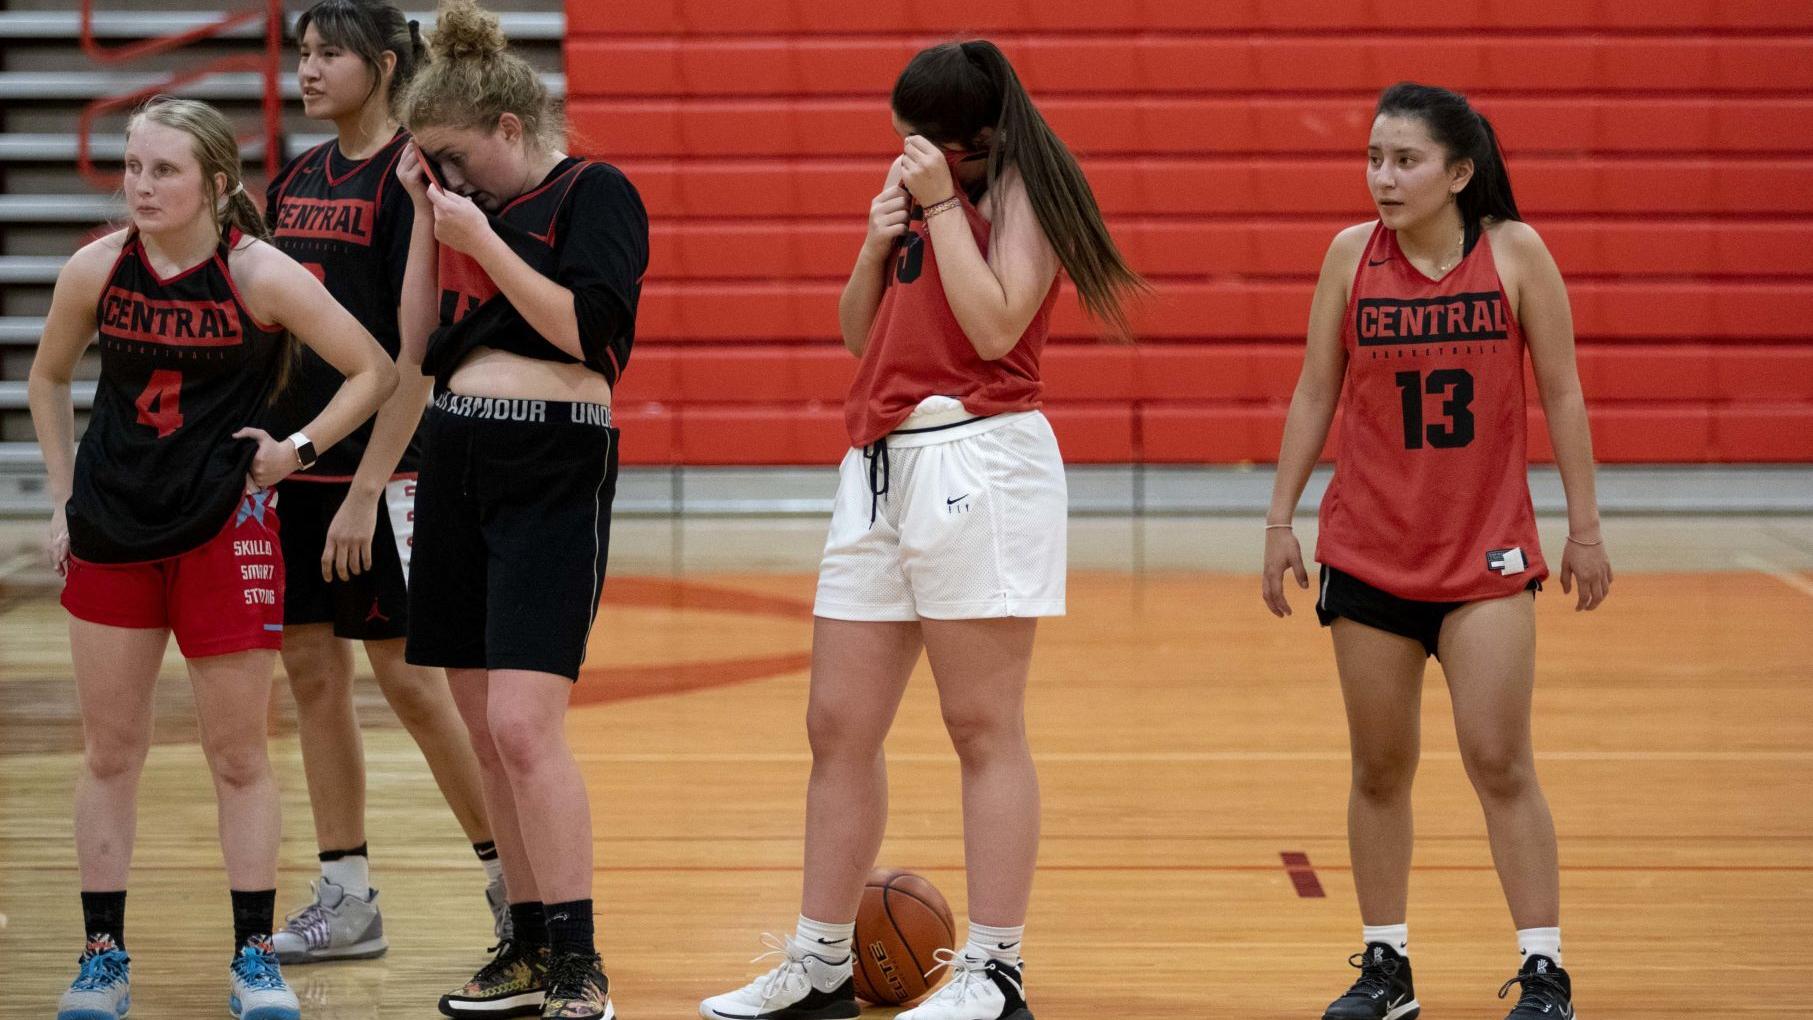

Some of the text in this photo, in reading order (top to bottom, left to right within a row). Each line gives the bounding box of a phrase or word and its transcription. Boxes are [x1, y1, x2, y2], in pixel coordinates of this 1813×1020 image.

[104, 295, 238, 338] CENTRAL
[1361, 301, 1507, 338] CENTRAL
[135, 369, 184, 438] 4
[447, 396, 546, 422] ARMOUR
[571, 402, 611, 428] UND
[1395, 368, 1475, 450] 13
[868, 939, 909, 1000] ELITE
